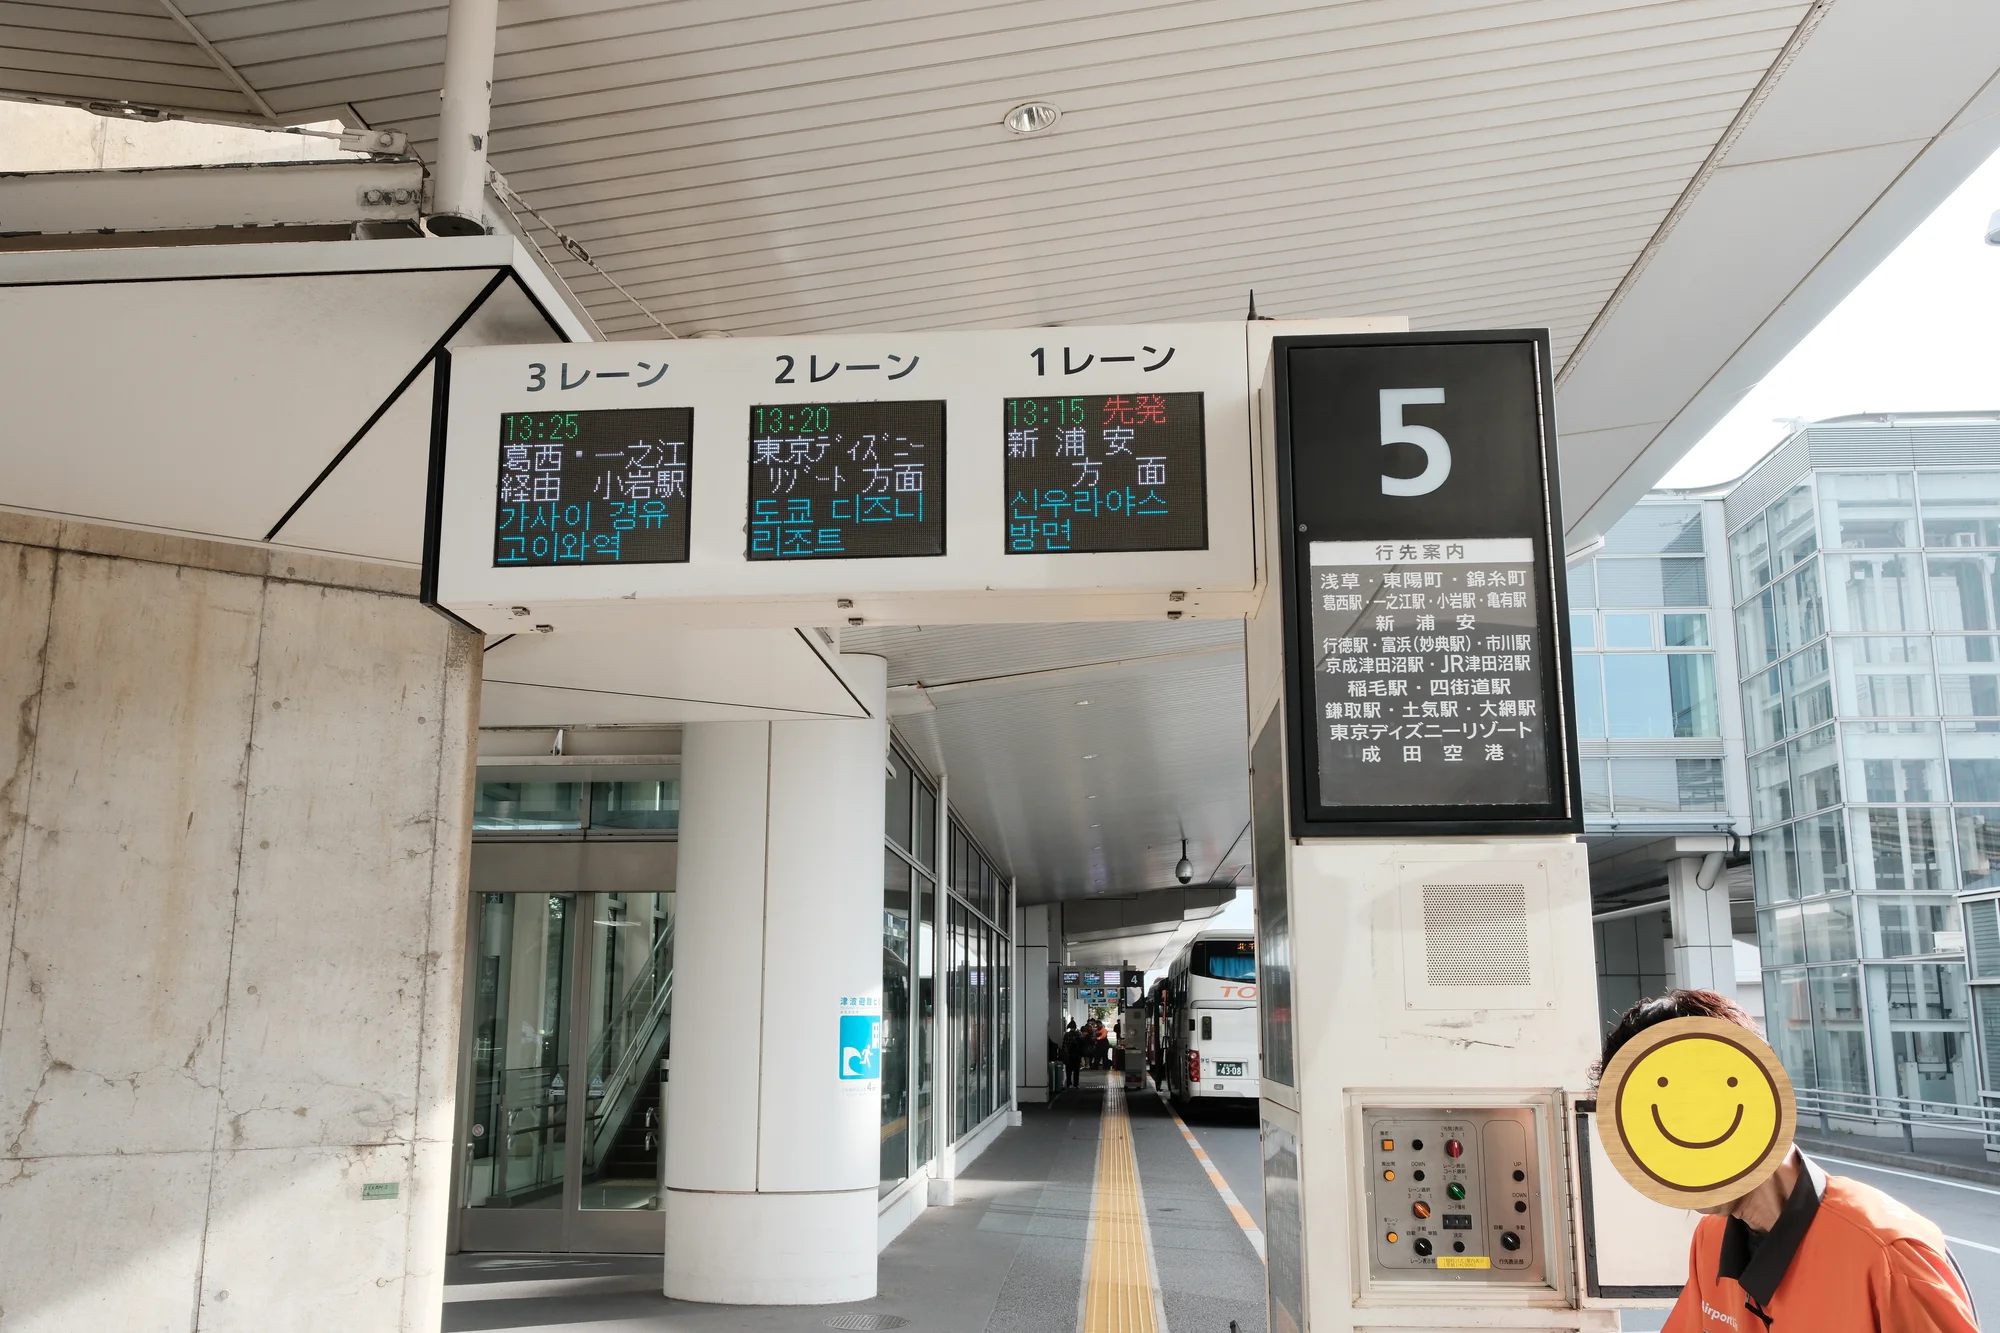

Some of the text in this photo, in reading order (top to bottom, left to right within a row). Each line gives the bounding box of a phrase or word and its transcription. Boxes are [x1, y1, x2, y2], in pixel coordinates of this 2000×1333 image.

[775, 354, 919, 384] 2レーン
[1030, 345, 1175, 376] 1レーン
[526, 361, 669, 392] 3レーン
[756, 406, 829, 433] 13:20
[1010, 394, 1166, 426] 13:15 先発
[506, 413, 579, 440] 13:25
[1379, 387, 1452, 497] 5
[501, 470, 686, 502] 経由 小岩駅
[862, 463, 924, 493] 方面
[499, 500, 669, 532] 가사이 경유
[752, 492, 923, 525] 도쿄 디즈니
[1010, 487, 1168, 518] 신우라야스
[497, 531, 620, 562] 고이와역
[753, 526, 845, 556] 리조트
[1010, 519, 1070, 550] 방면
[1375, 543, 1464, 561] 行先案内
[1329, 721, 1533, 741] 東京ディズニーリゾート
[1131, 975, 1138, 985] 4
